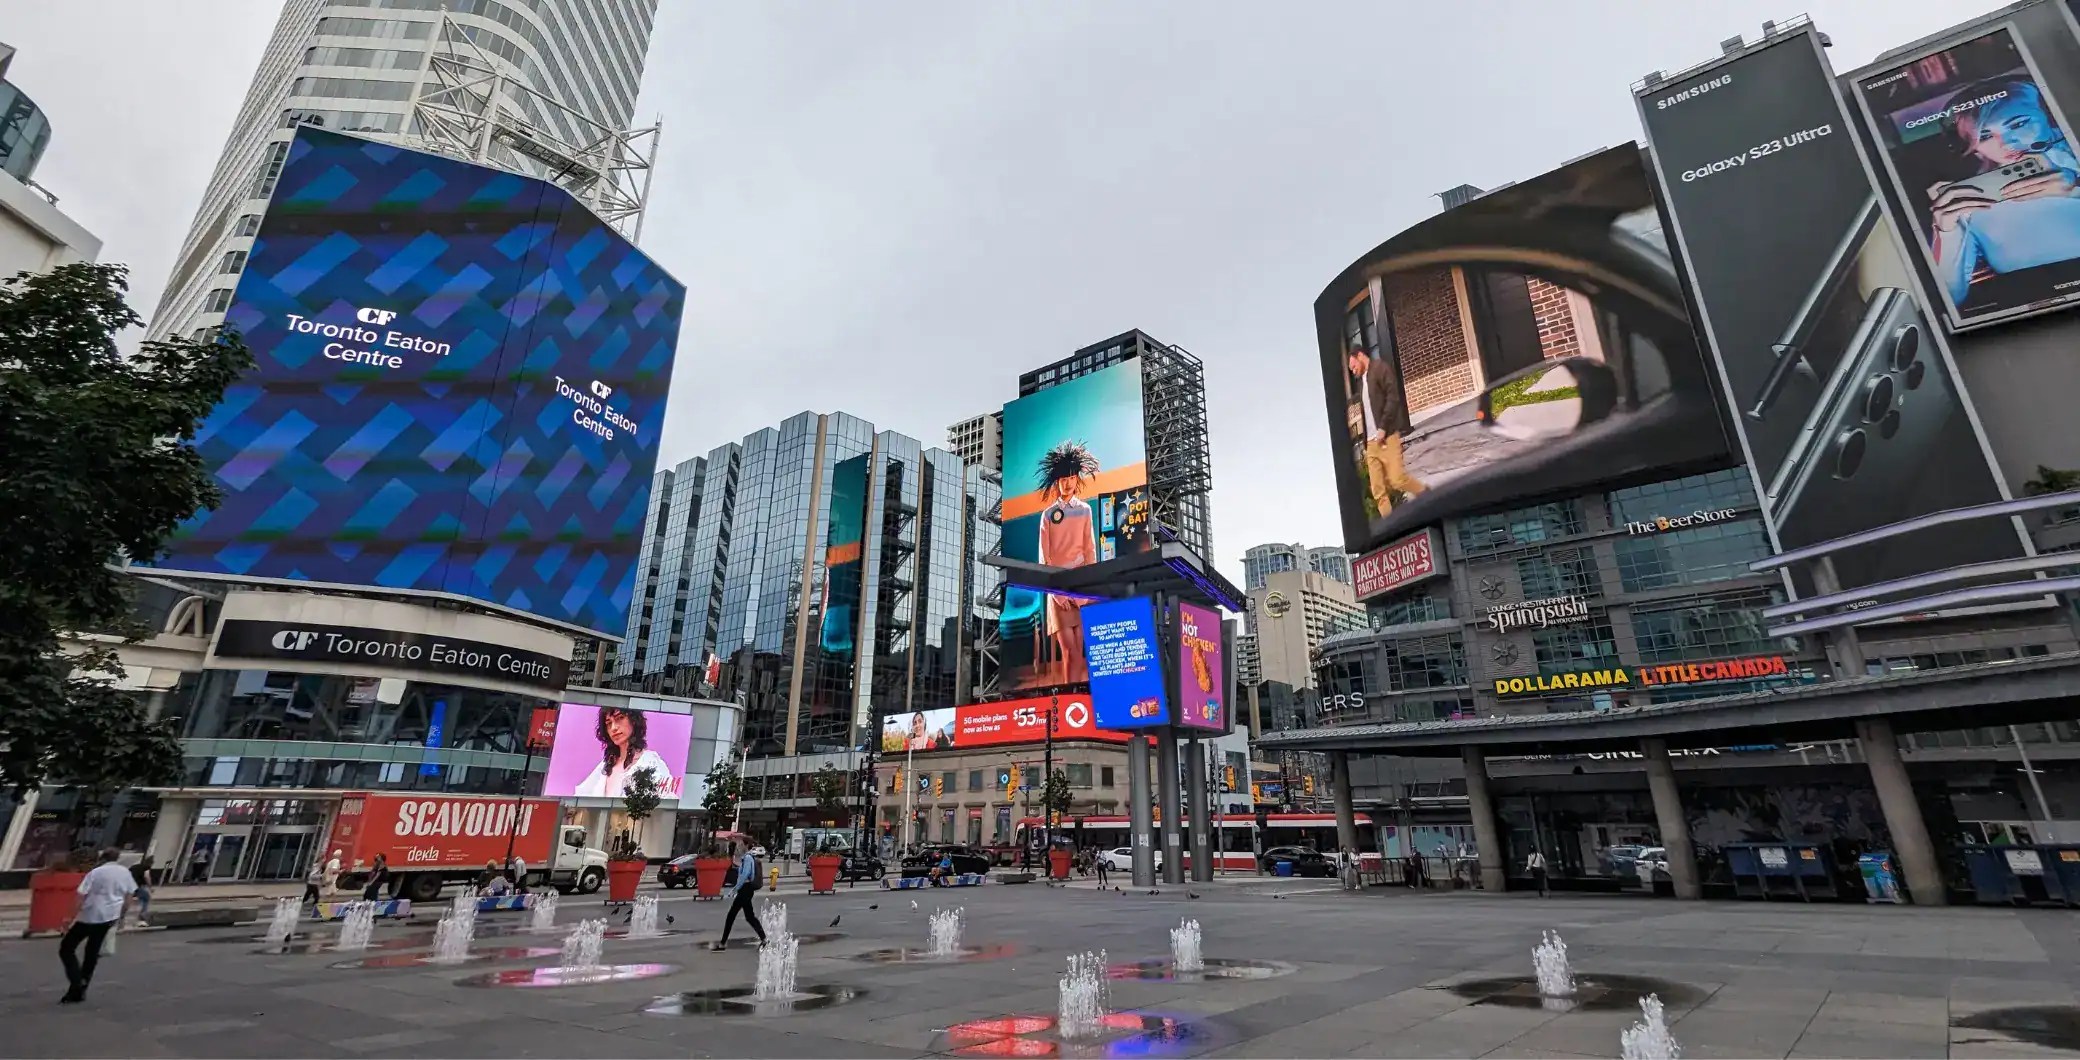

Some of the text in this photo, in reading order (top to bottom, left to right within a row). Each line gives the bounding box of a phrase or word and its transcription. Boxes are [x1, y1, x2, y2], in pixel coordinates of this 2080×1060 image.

[1657, 74, 1732, 110] SAMSUNG
[1866, 71, 1908, 90] SAMSUNG
[1905, 90, 2008, 129] Galaxy S23 Ultra
[1681, 124, 1832, 183] Galaxy S23 Ultra
[356, 307, 397, 326] CF
[286, 313, 451, 356] Toronto Eaton
[323, 342, 403, 369] Centre
[591, 380, 612, 400] CF
[555, 375, 637, 435] Toronto Eaton
[573, 408, 614, 441] Centre
[1129, 500, 1148, 512] POT
[1128, 512, 1148, 525] BAT
[1623, 508, 1736, 535] The Beer Store
[1356, 539, 1429, 583] JACK ASTOR'S
[1357, 563, 1415, 595] PARTY IS THIS WAY
[1486, 595, 1568, 614] LOUNGE RESTAURANT
[1117, 620, 1136, 628] PEOPLE
[1182, 611, 1194, 624] I'M
[1182, 623, 1198, 637] NOT
[271, 630, 551, 679] CF Toronto Eaton Centre
[1700, 656, 1787, 679] CANADA
[1495, 668, 1630, 694] DOLLARAMA
[963, 716, 972, 725] 5G
[972, 714, 991, 724] mobile
[992, 712, 1008, 722] plans
[963, 722, 1001, 734] now as low as
[394, 800, 534, 837] SCAVOLINI
[407, 846, 439, 862] dekla
